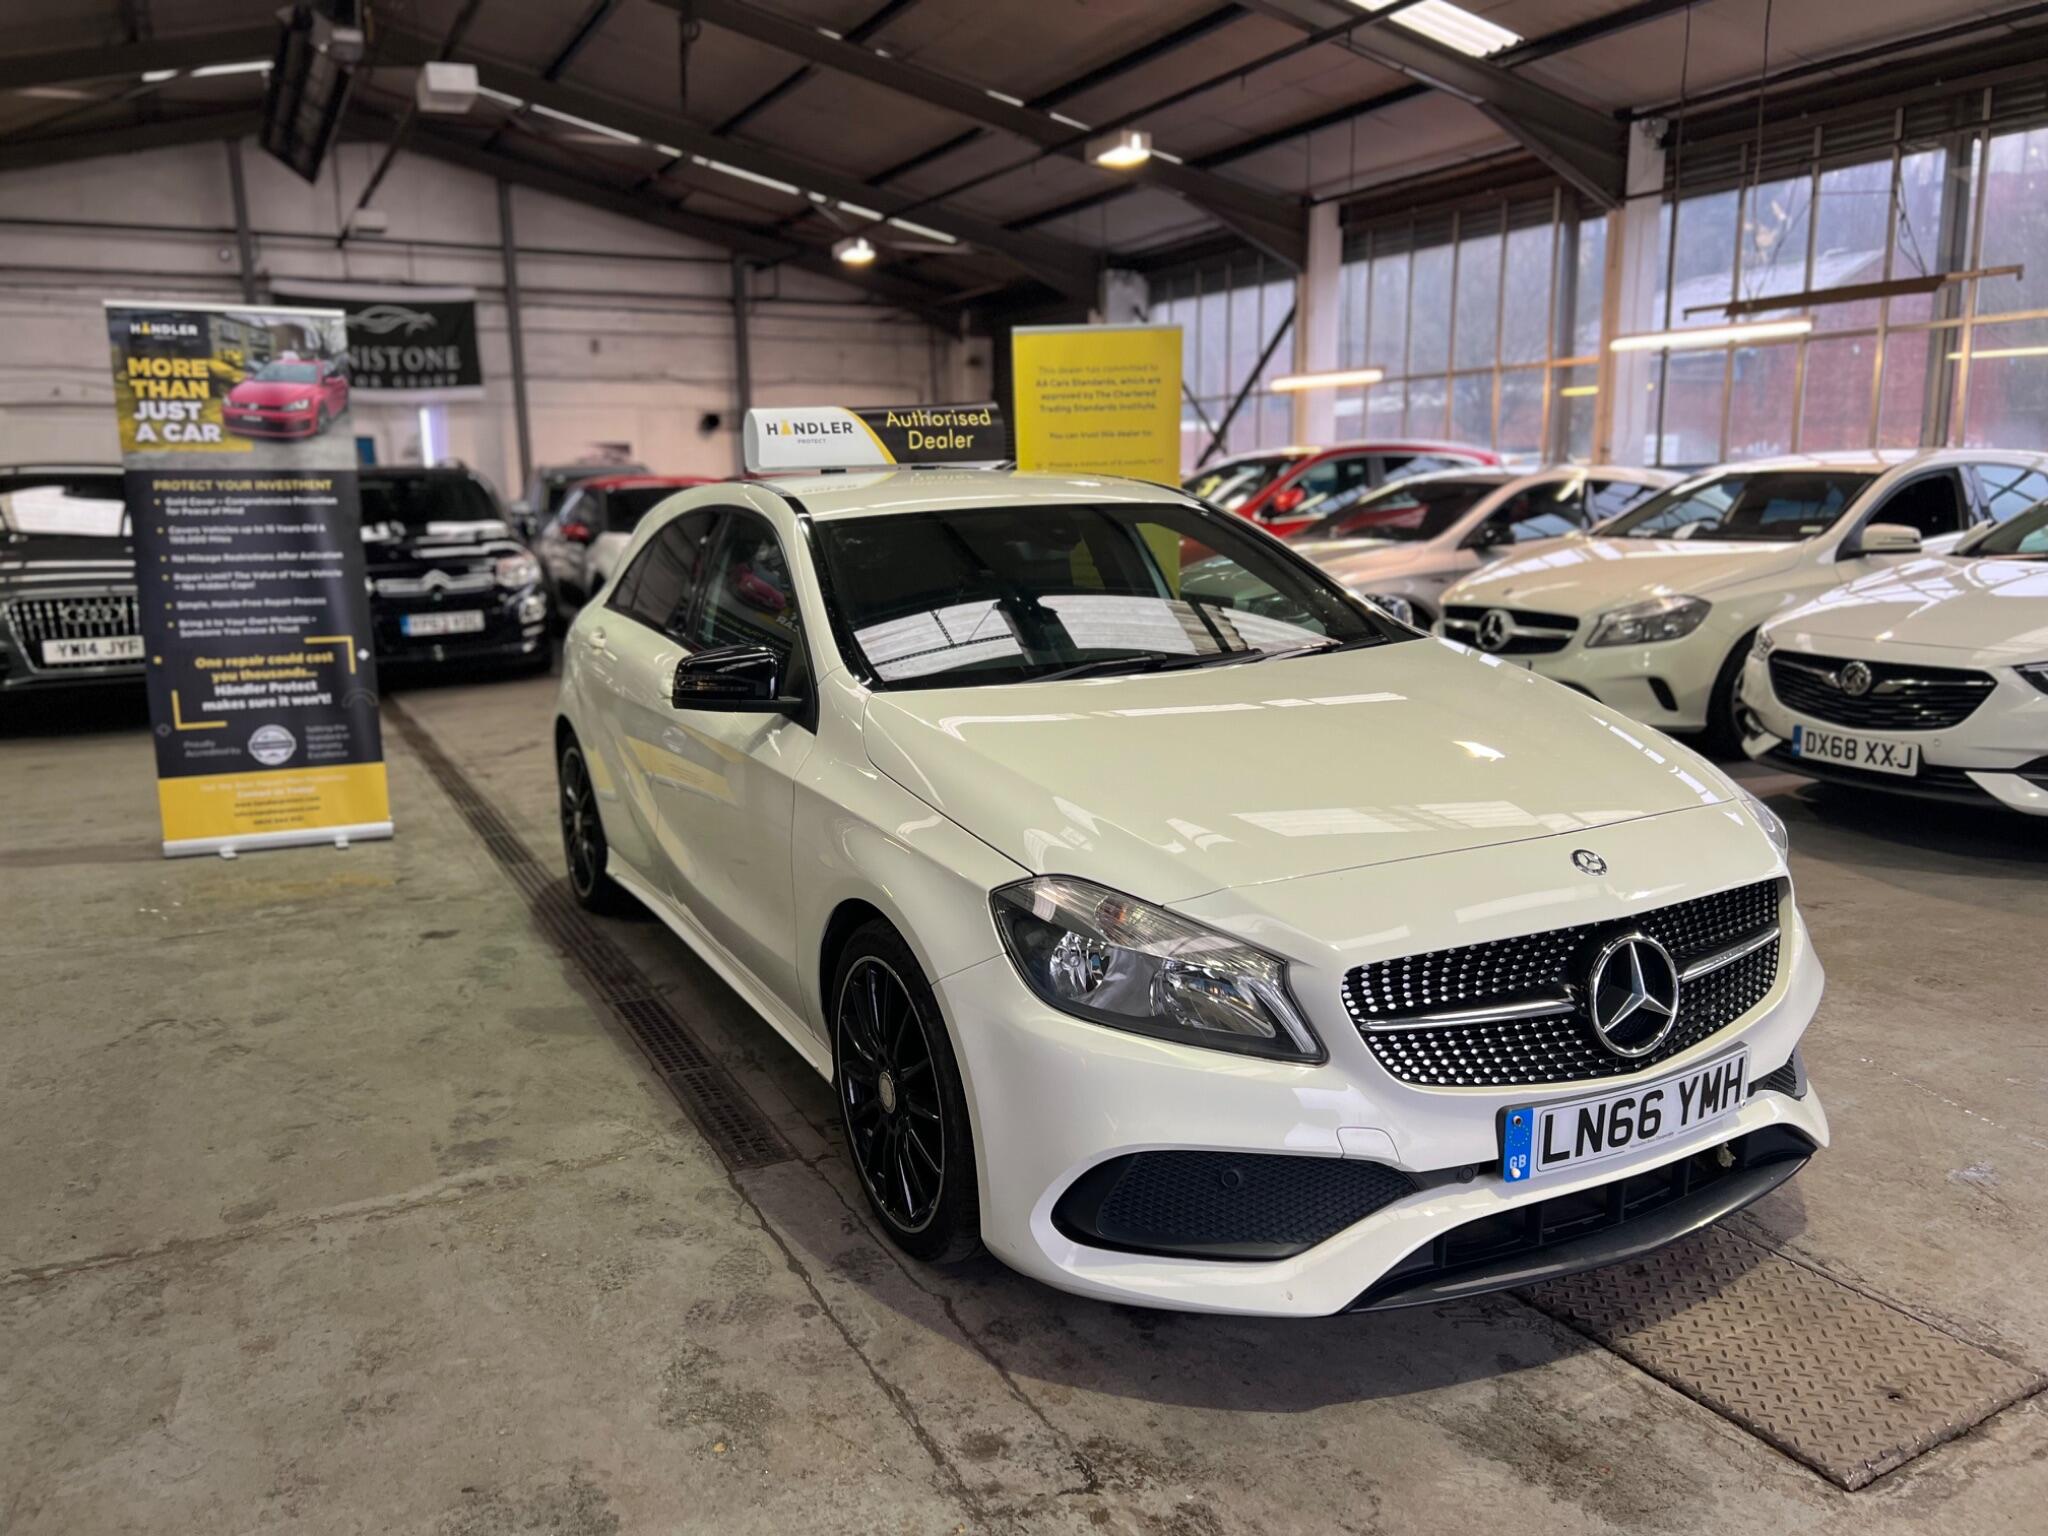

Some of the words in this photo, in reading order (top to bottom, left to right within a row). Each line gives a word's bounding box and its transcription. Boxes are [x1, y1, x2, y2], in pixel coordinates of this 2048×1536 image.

[128, 357, 208, 378] MORE
[130, 379, 209, 399] THAN
[1120, 376, 1145, 385] which
[133, 401, 202, 420] JUST
[886, 408, 992, 428] Authorised
[136, 423, 158, 442] A
[163, 423, 222, 442] CAR
[908, 429, 975, 450] Dealer
[153, 480, 213, 491] PROTECT
[216, 480, 252, 491] YOUR
[255, 479, 333, 491] INVESTMENT
[194, 657, 223, 669] One
[226, 653, 266, 668] repair
[267, 652, 304, 665] could
[306, 652, 334, 663] cost
[212, 672, 238, 683] you
[269, 680, 318, 693] Protect
[202, 698, 247, 711] makes
[248, 697, 277, 709] sure
[278, 694, 290, 706] it
[1804, 731, 1858, 761] DX68
[1864, 741, 1912, 769] XXJ
[1542, 1090, 1664, 1164] LN66
[1678, 1057, 1744, 1126] YMH
[1509, 1154, 1527, 1168] GB
